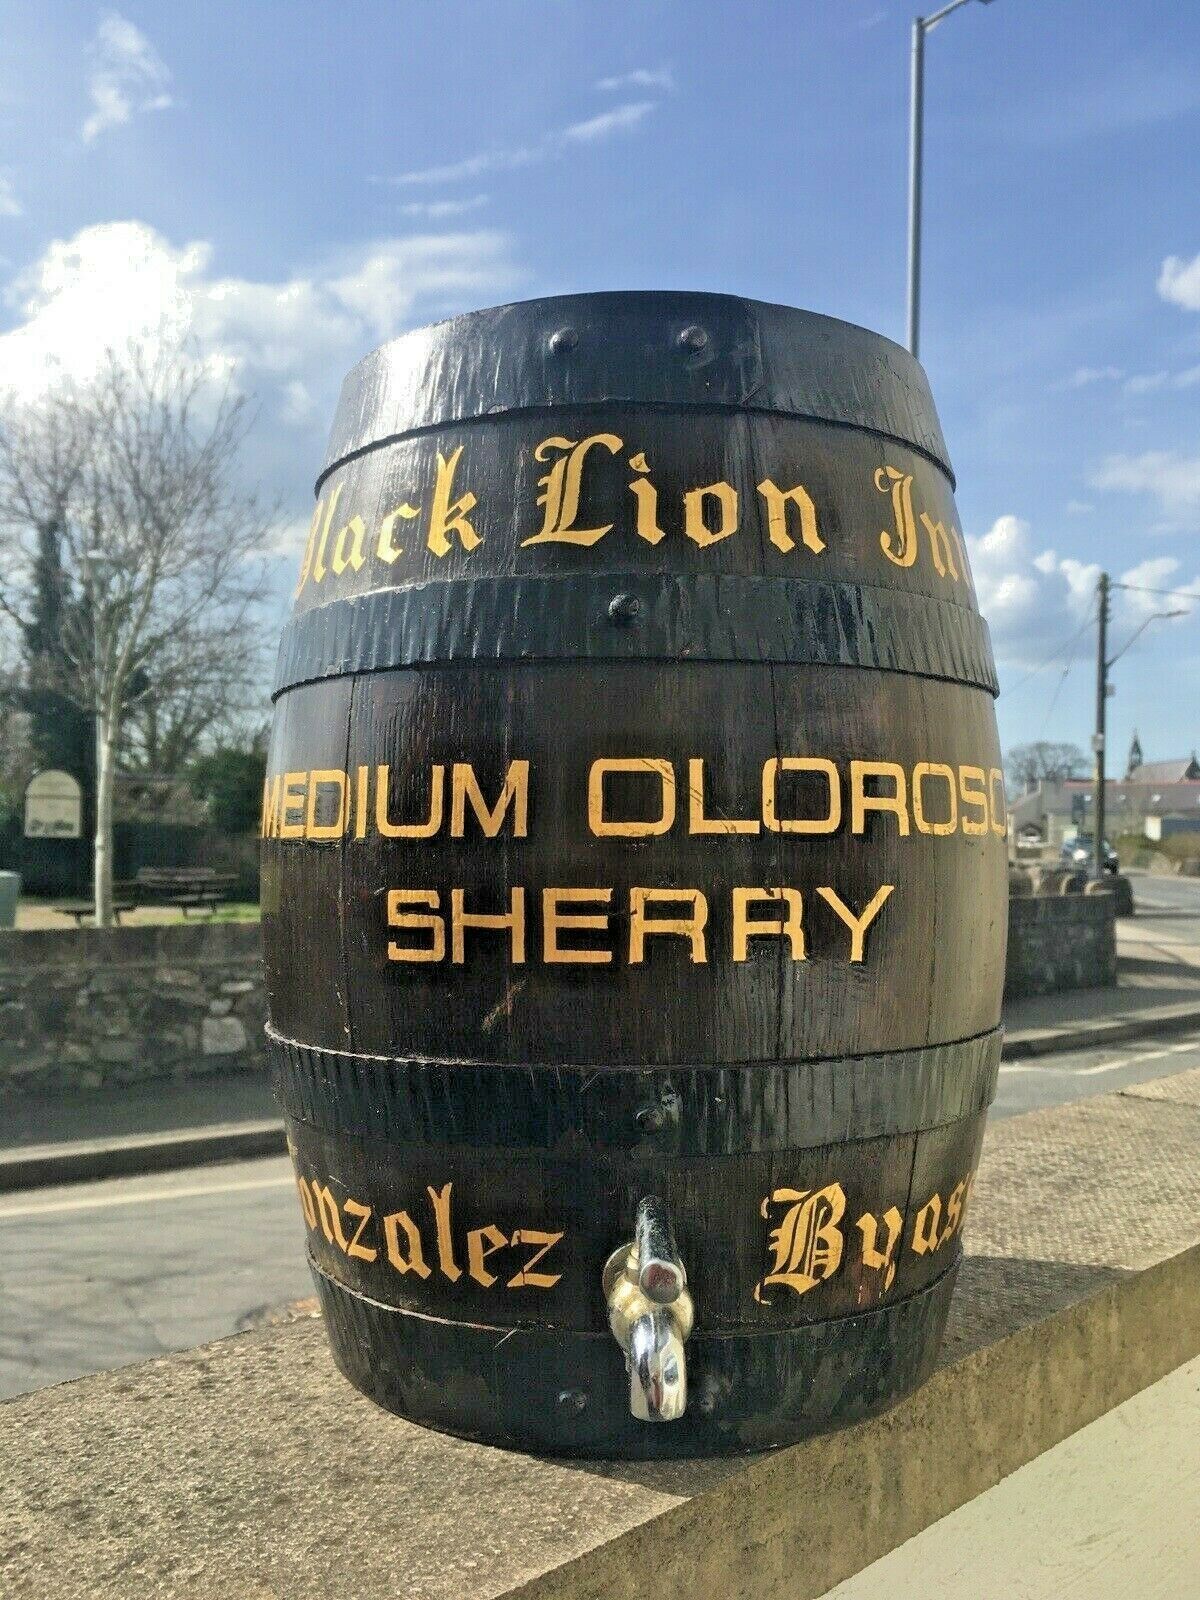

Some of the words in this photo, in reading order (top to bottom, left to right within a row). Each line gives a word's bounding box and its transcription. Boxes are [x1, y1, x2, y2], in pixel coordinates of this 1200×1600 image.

[520, 433, 826, 554] Lion
[262, 760, 529, 838] MEDIUM
[588, 758, 1006, 836] OLOROSO
[387, 885, 894, 965] SHERRY
[299, 1175, 564, 1288] onzalez
[752, 1172, 975, 1305] Byas
